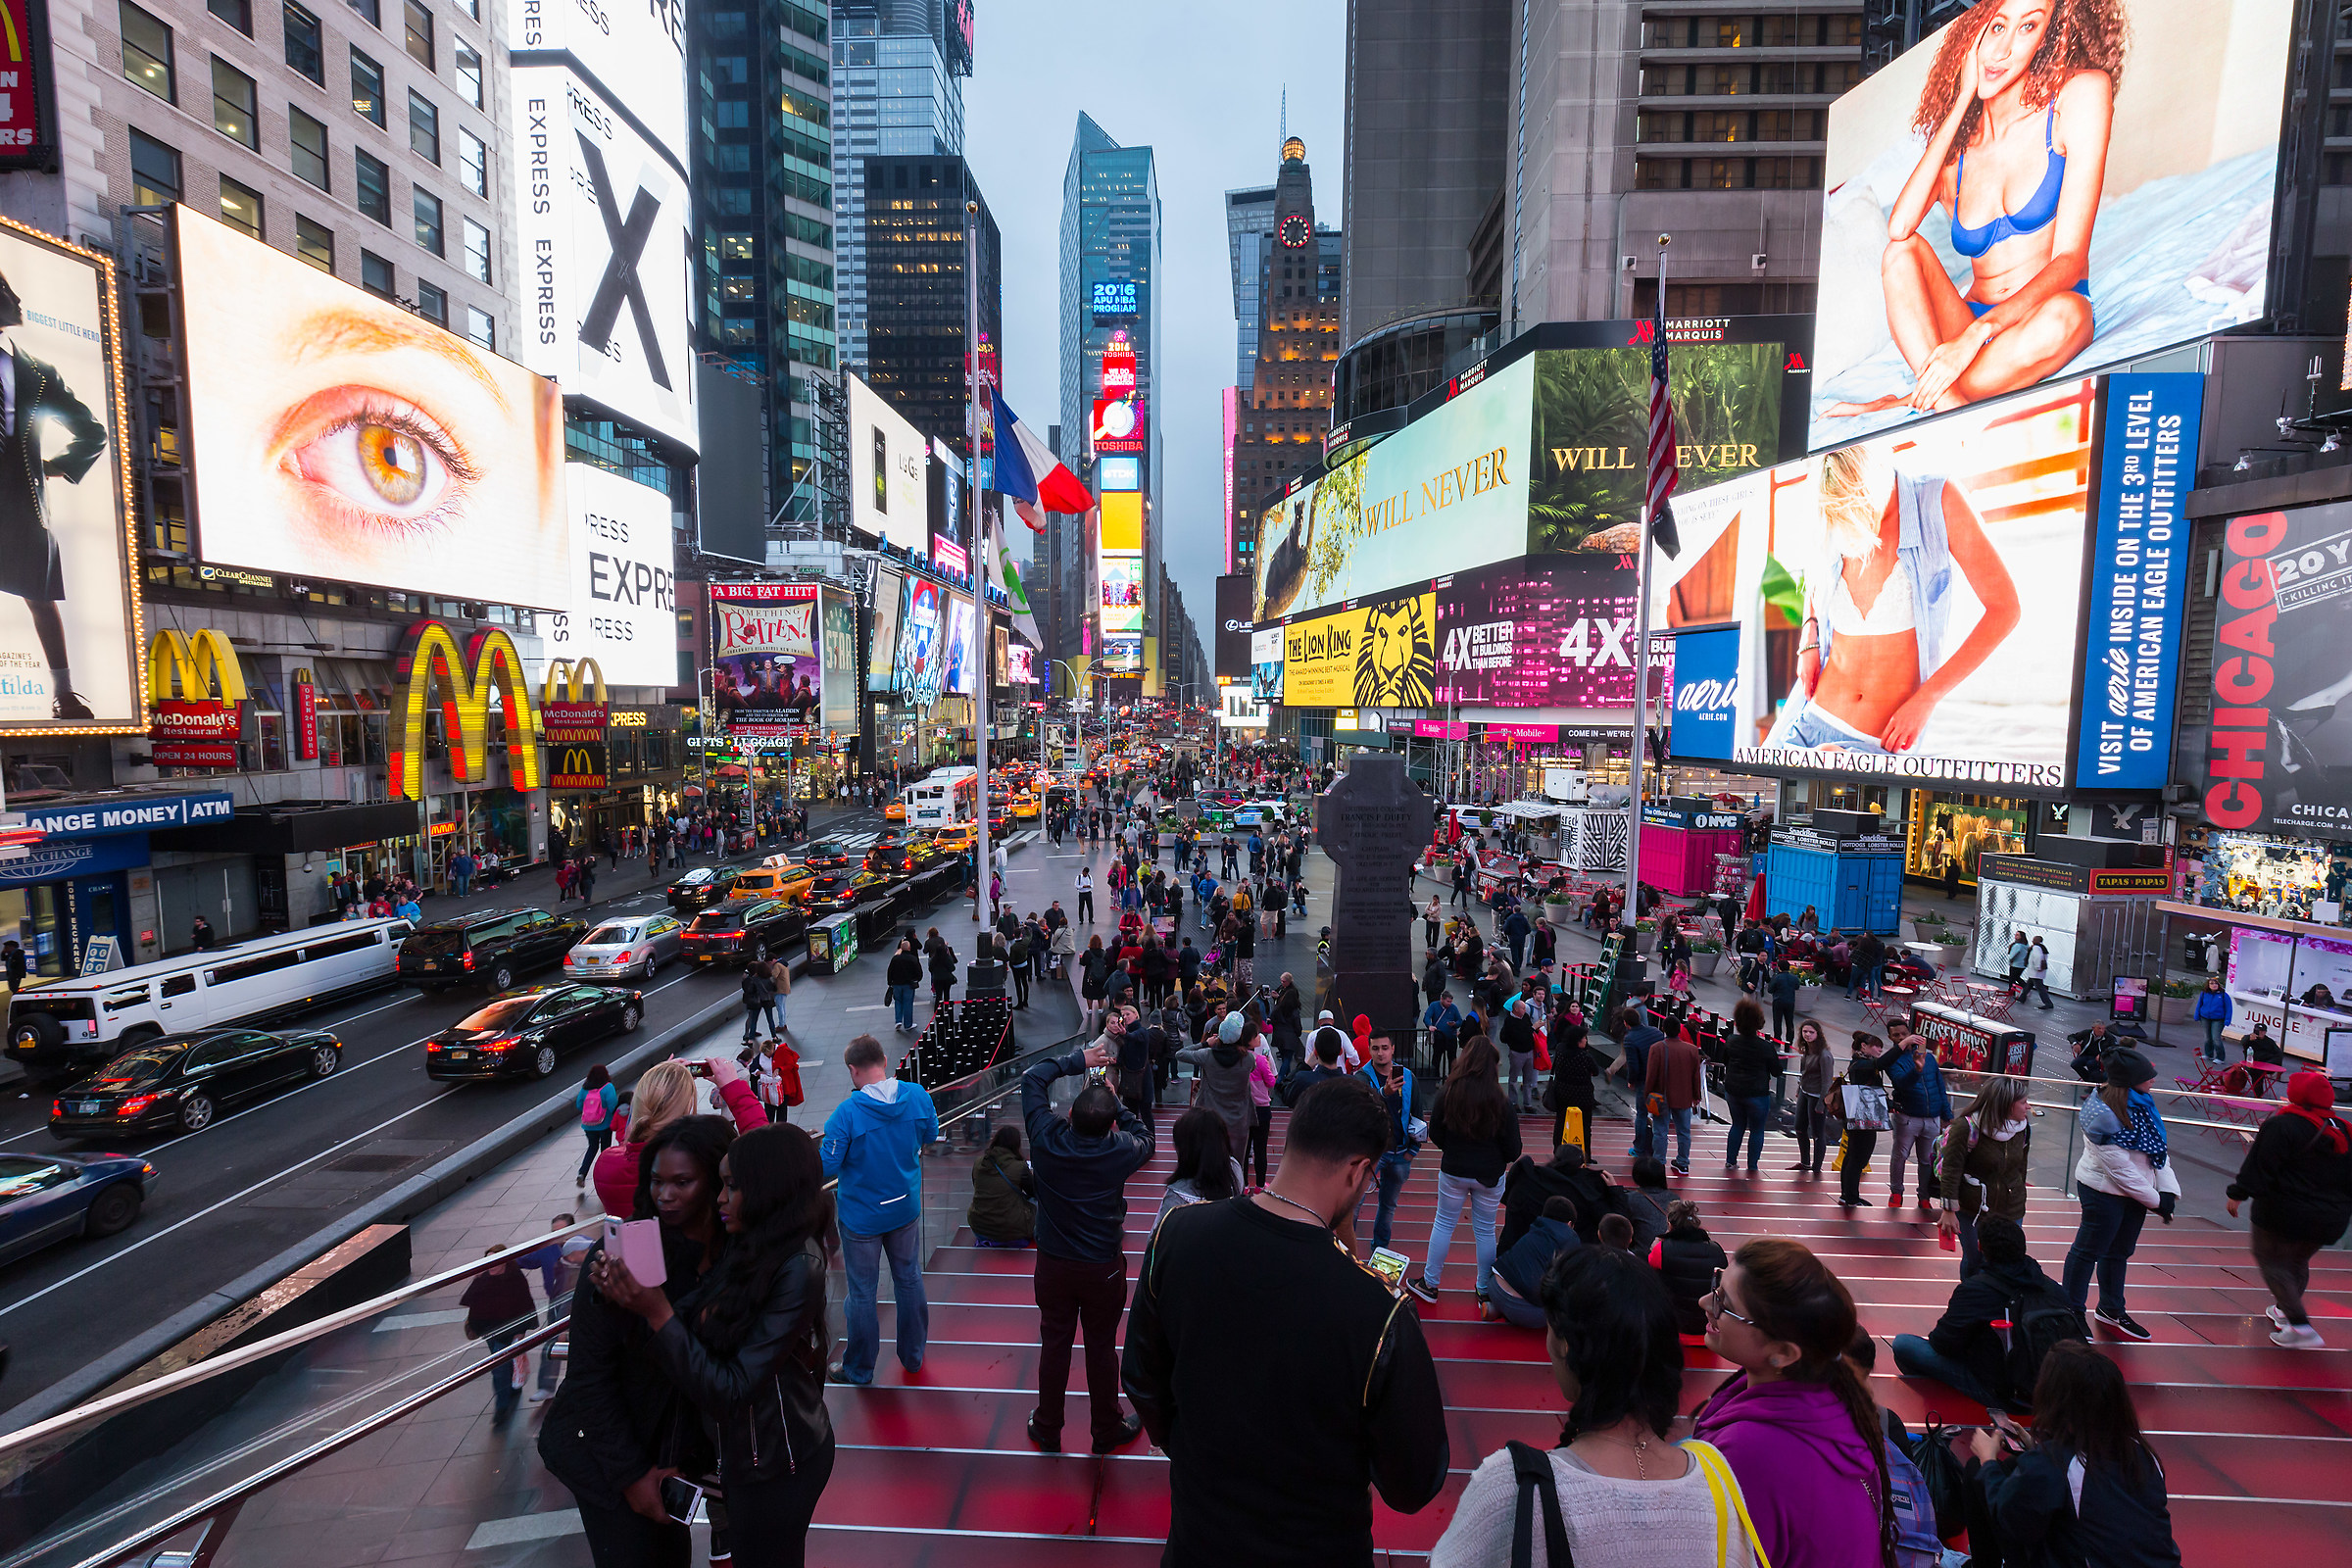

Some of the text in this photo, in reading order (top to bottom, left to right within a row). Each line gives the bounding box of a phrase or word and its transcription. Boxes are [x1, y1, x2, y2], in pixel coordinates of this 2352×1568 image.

[528, 99, 550, 215] EXPRESS
[535, 239, 556, 344] EXPRESS
[26, 310, 100, 343] BIGGEST LITTLE HERO
[1666, 319, 1731, 328] MARRIOTT
[1666, 330, 1722, 340] MARQUIS
[1108, 342, 1130, 351] 2016
[1460, 359, 1488, 381] MARRIOTT
[1460, 371, 1485, 391] MARQUIS
[1328, 422, 1351, 439] MARRIOTT
[1095, 441, 1143, 451] TOSHIBA
[1551, 446, 1636, 471] WILL
[1364, 446, 1511, 538] WILL NEVER
[2276, 551, 2325, 585] 20
[2098, 390, 2153, 774] VISIT aerie INSIDE ON THE 3RD LEVEL
[2130, 415, 2181, 752] OF AMERICAN EAGLE OUTFITTERS
[729, 586, 754, 597] BIG,
[758, 586, 780, 597] FAT
[2289, 580, 2337, 602] KILLING
[730, 607, 801, 618] SOMETHING
[1472, 620, 1514, 644] BETTER
[1289, 624, 1351, 662] THE LION KING
[1444, 626, 1473, 670] 4X
[1472, 642, 1513, 655] IN BUILDINGS
[1559, 618, 1633, 667] 4X
[1472, 658, 1512, 669] THAN BEFORE
[2205, 511, 2287, 829] CHICAGO
[0, 675, 45, 695] tilda
[298, 687, 311, 712] OPEN
[150, 712, 236, 726] McDonald's
[544, 710, 605, 719] McDonald's
[1698, 712, 1727, 721] AERIE.COM
[687, 737, 793, 748] GIFTS LUGGAGE
[154, 752, 181, 760] OPEN
[198, 751, 231, 760] HOURS
[1735, 747, 2062, 787] AMERICAN EAGLE OUTFITTERS
[103, 801, 230, 827] MONEY ATM
[1653, 808, 1668, 817] Official
[2291, 804, 2352, 819] CHICA
[1708, 815, 1737, 827] NYC
[2274, 817, 2333, 829] TELECHARGE.COM
[1788, 827, 1818, 838] SnackBox
[1797, 835, 1819, 844] LOBSTER
[24, 846, 93, 864] EXCHANGE
[2042, 867, 2073, 876] TORTILLAS
[2099, 877, 2166, 886] TAPAS PAPAS
[72, 918, 80, 970] EXCHANGE
[1915, 1018, 1958, 1041] JERSEY
[2008, 1042, 2027, 1055] JERSEY
